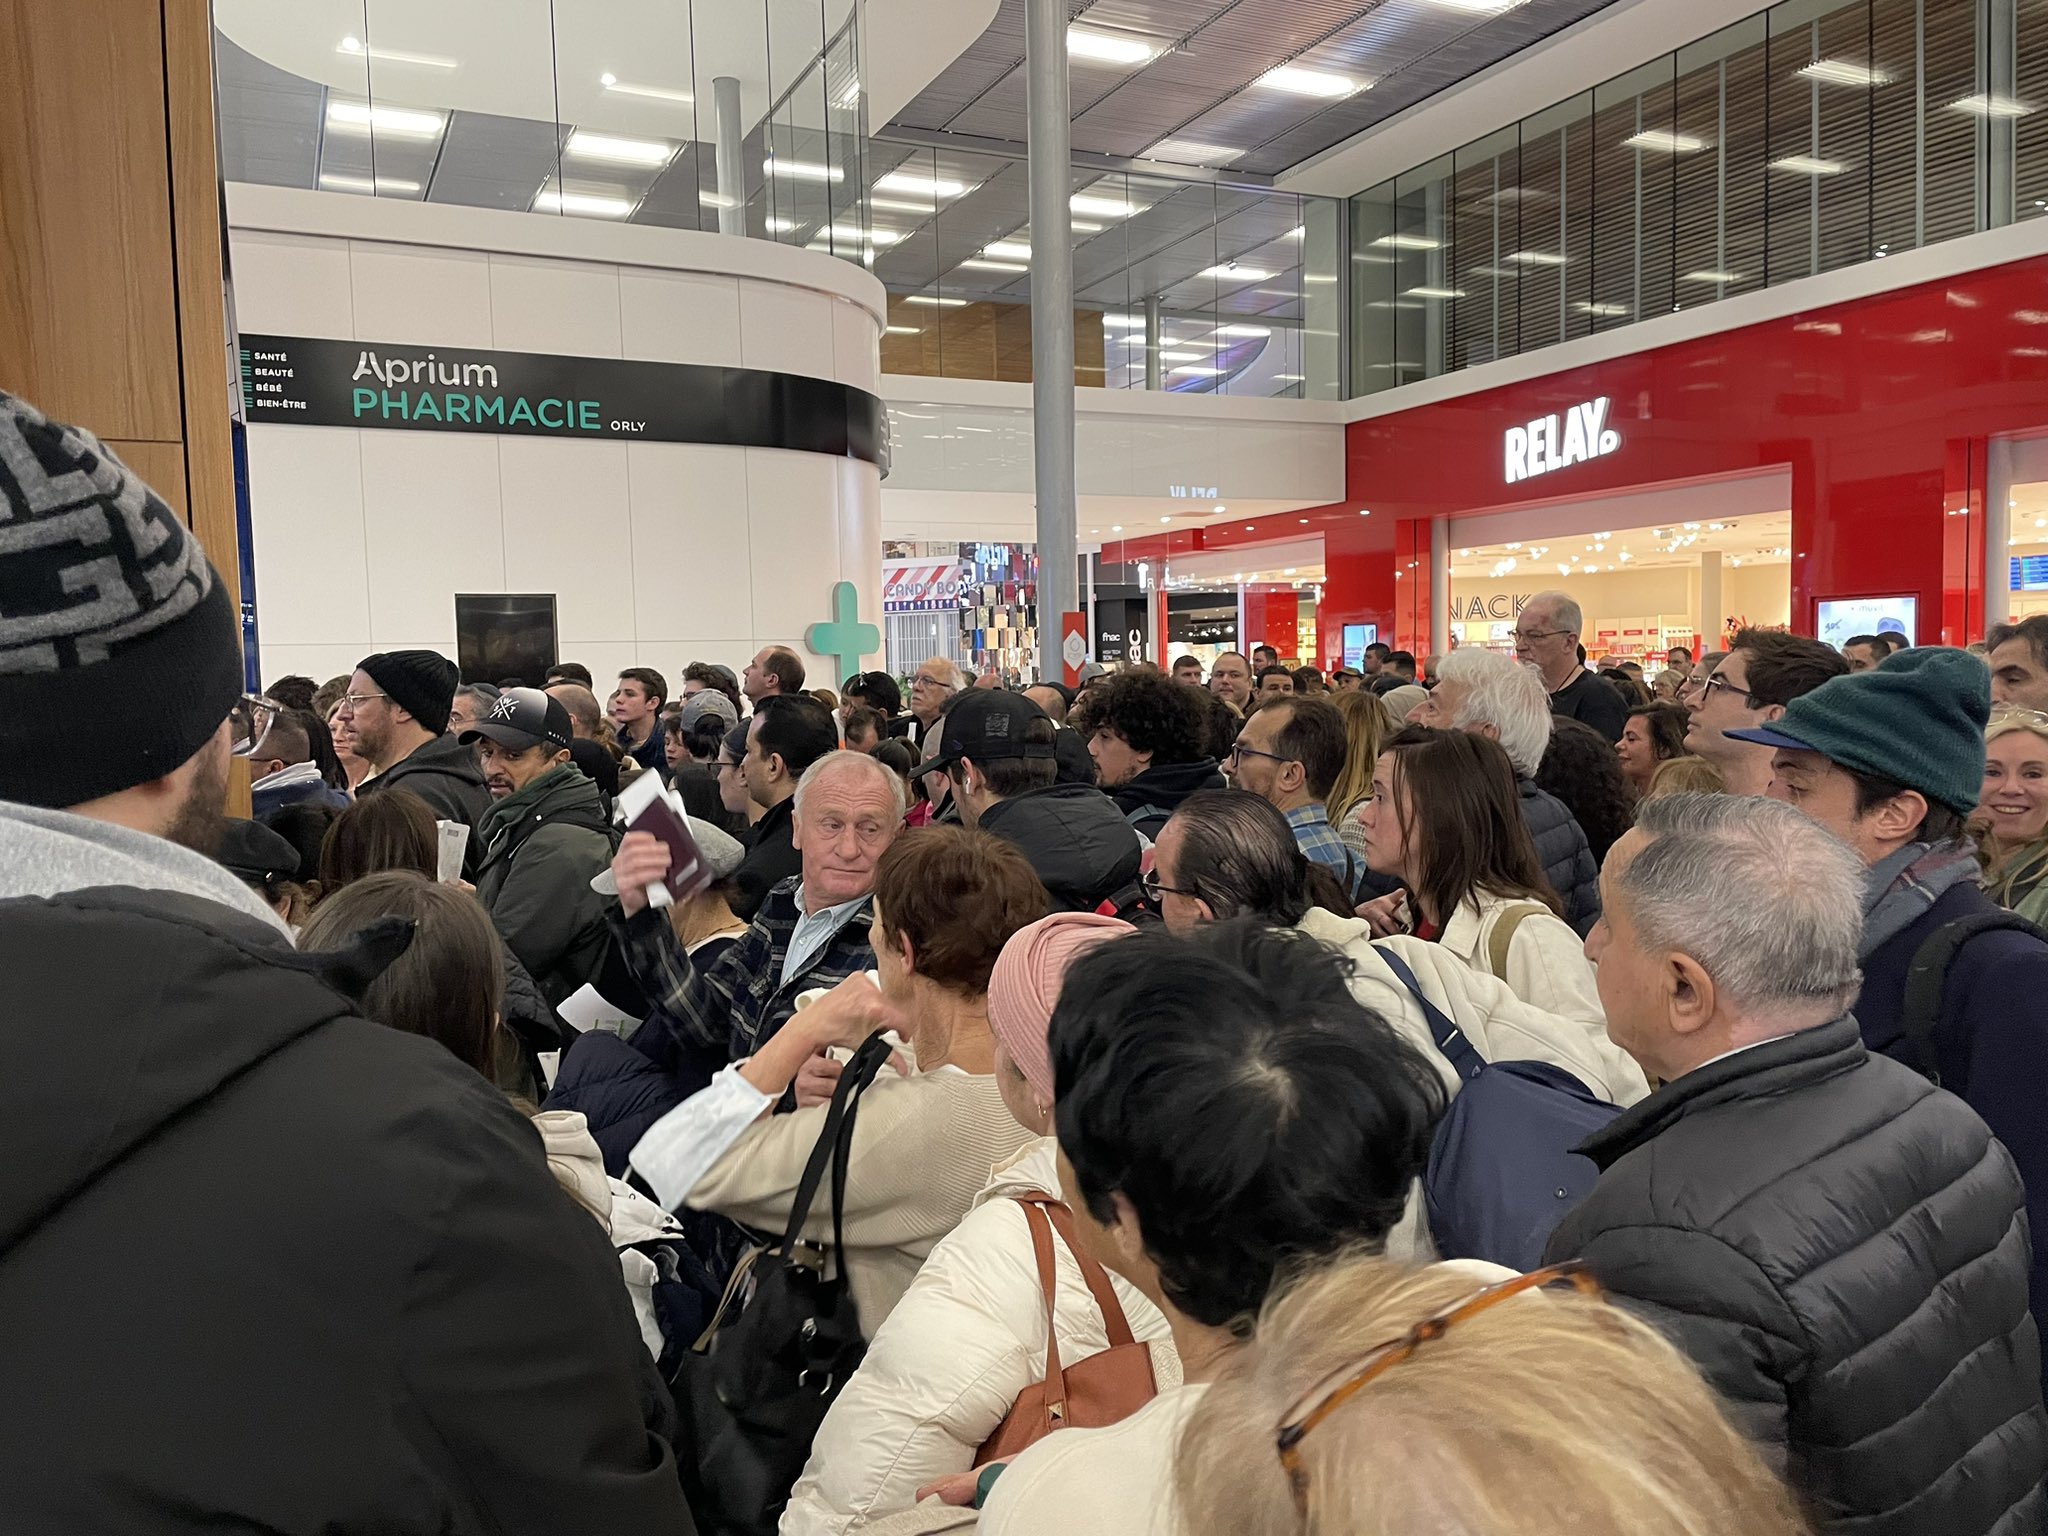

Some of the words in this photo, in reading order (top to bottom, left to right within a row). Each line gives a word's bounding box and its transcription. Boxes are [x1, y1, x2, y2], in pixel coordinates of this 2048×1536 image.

[254, 352, 287, 362] SANTÉ
[254, 368, 294, 378] BEAUTÉ
[352, 351, 498, 388] Aprium
[255, 382, 283, 393] BÉBÉ
[353, 388, 602, 430] PHARMACIE
[610, 420, 646, 432] ORLY
[886, 583, 933, 597] CANDY
[937, 581, 959, 595] BO
[1102, 632, 1121, 641] fnac
